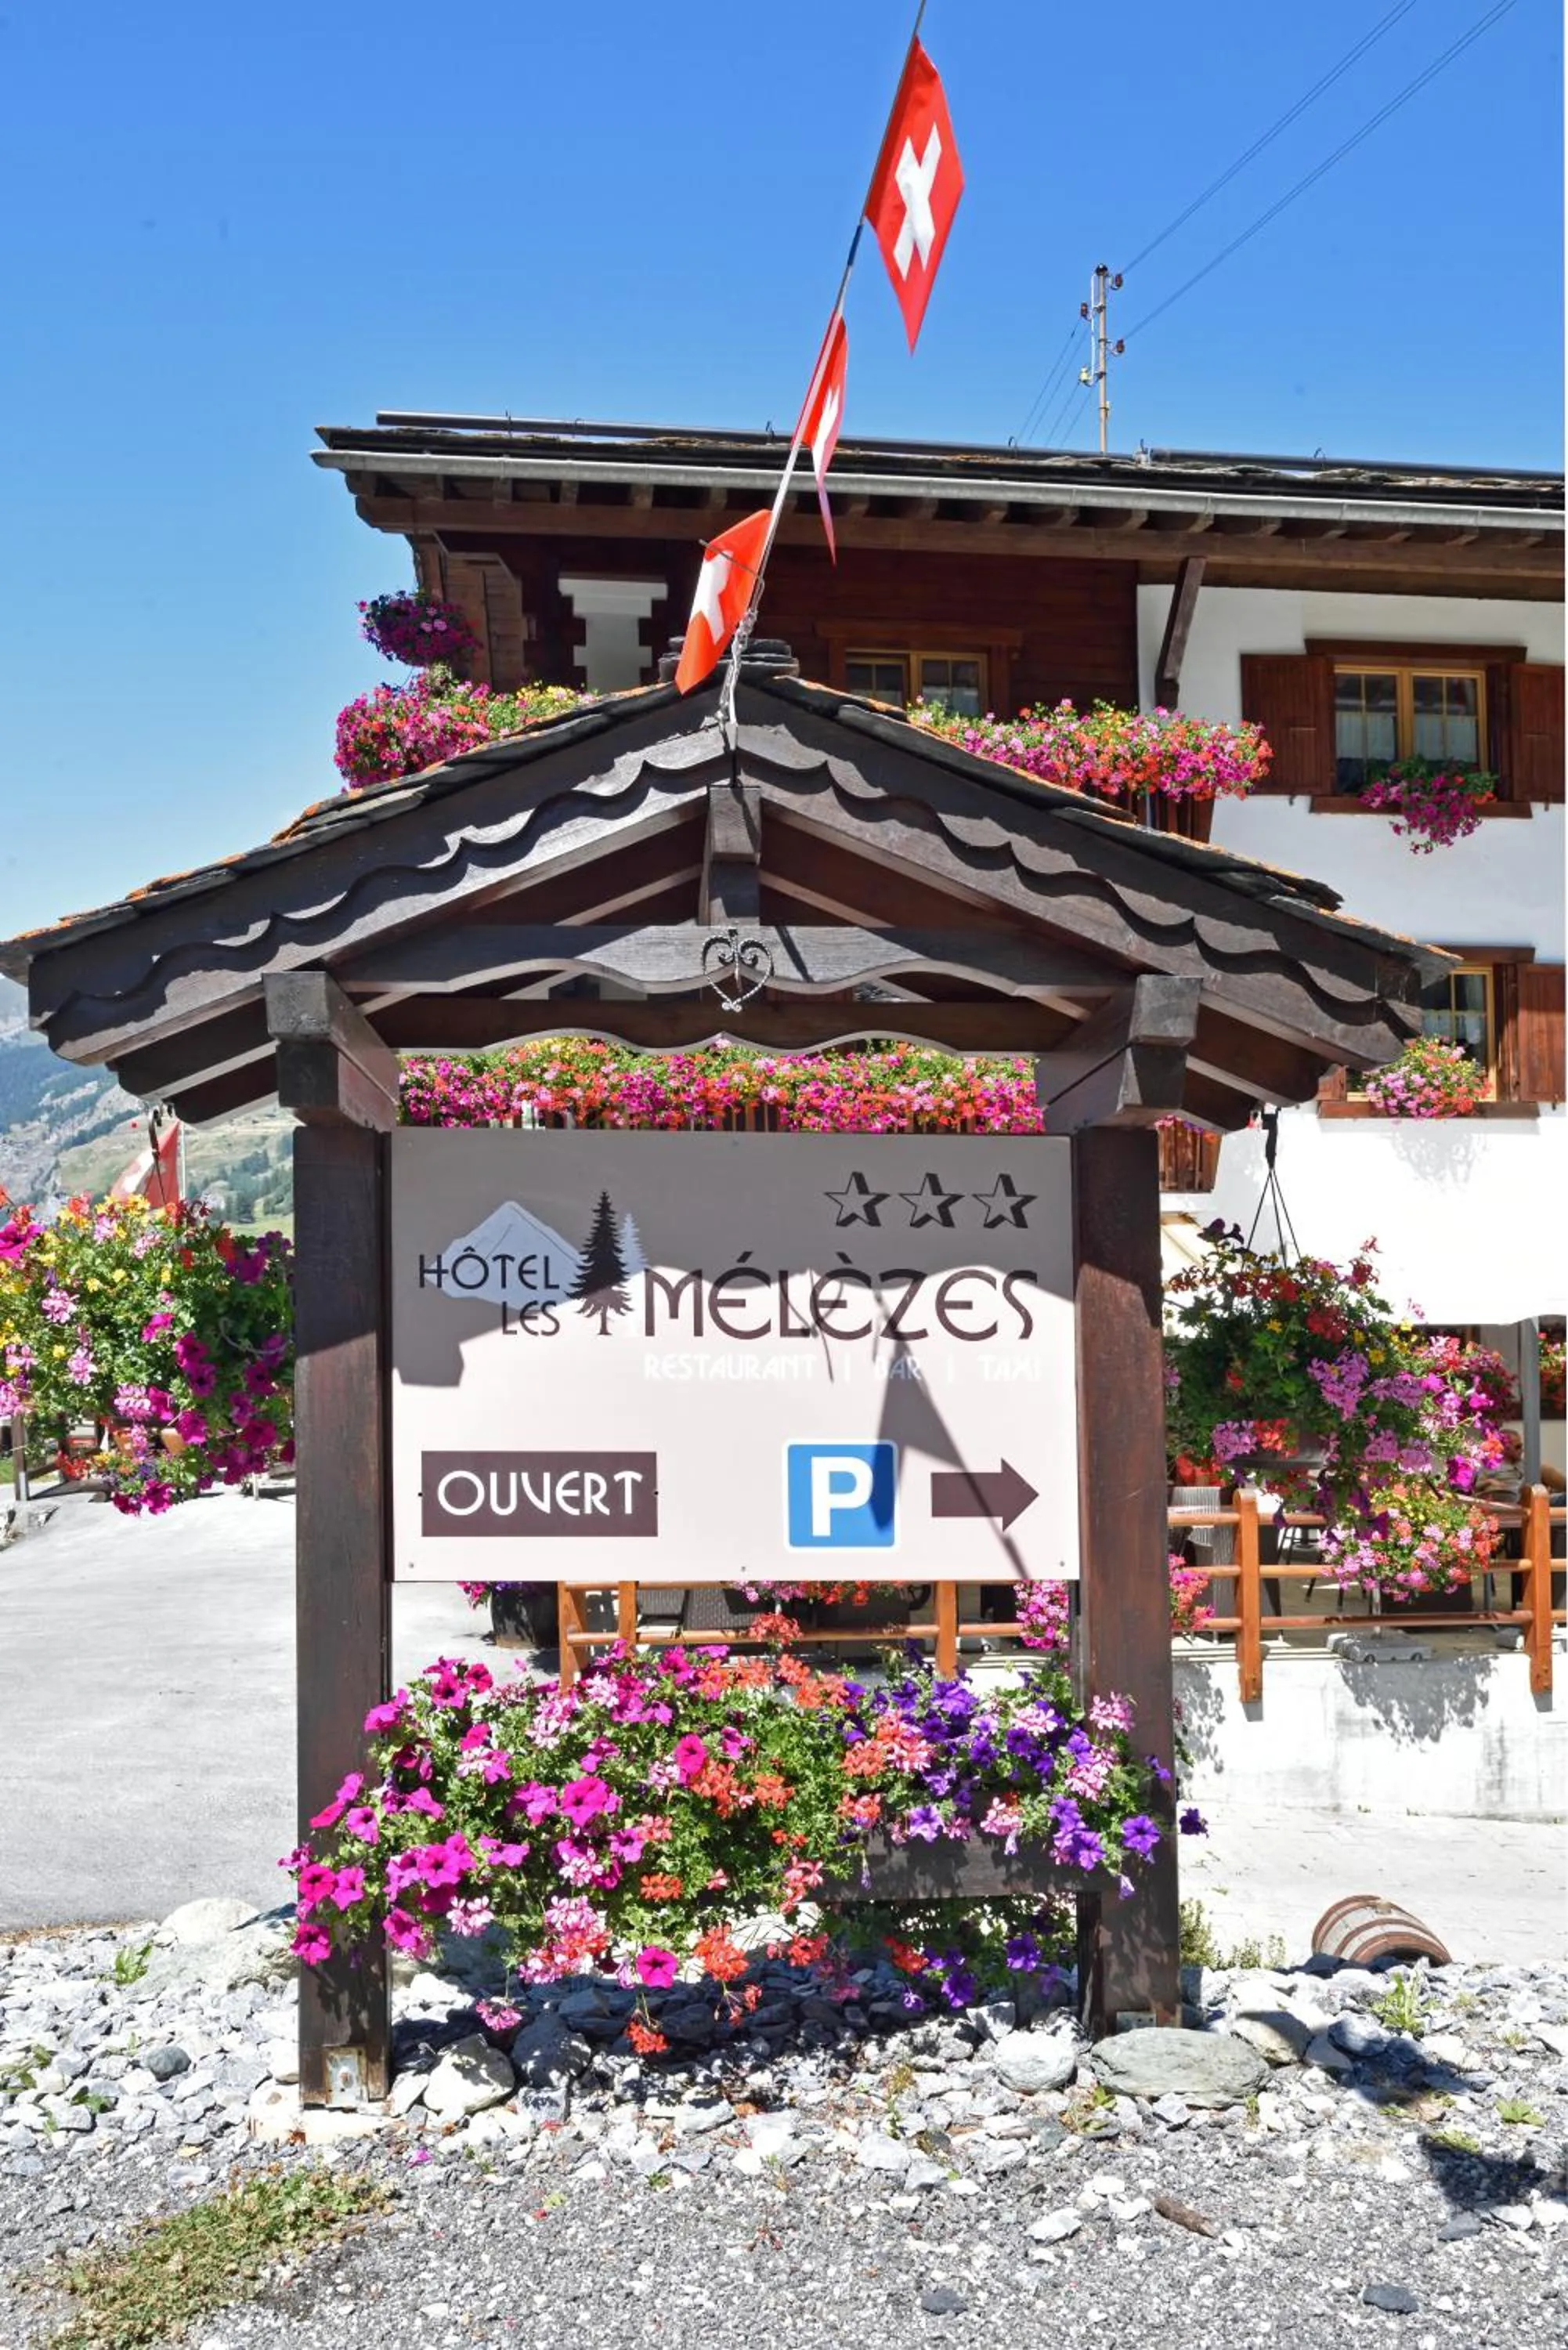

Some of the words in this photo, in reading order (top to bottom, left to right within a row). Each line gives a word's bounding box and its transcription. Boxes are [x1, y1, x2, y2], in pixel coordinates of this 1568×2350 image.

[418, 1247, 560, 1290] HÔTEL
[502, 1300, 561, 1336] LES
[644, 1251, 1039, 1341] MÉLÈZES
[643, 1353, 817, 1380] RESTAURANT
[874, 1354, 922, 1380] BAR
[977, 1354, 1042, 1380] TAXI
[437, 1470, 643, 1517] OUVERT
[811, 1456, 874, 1537] P
